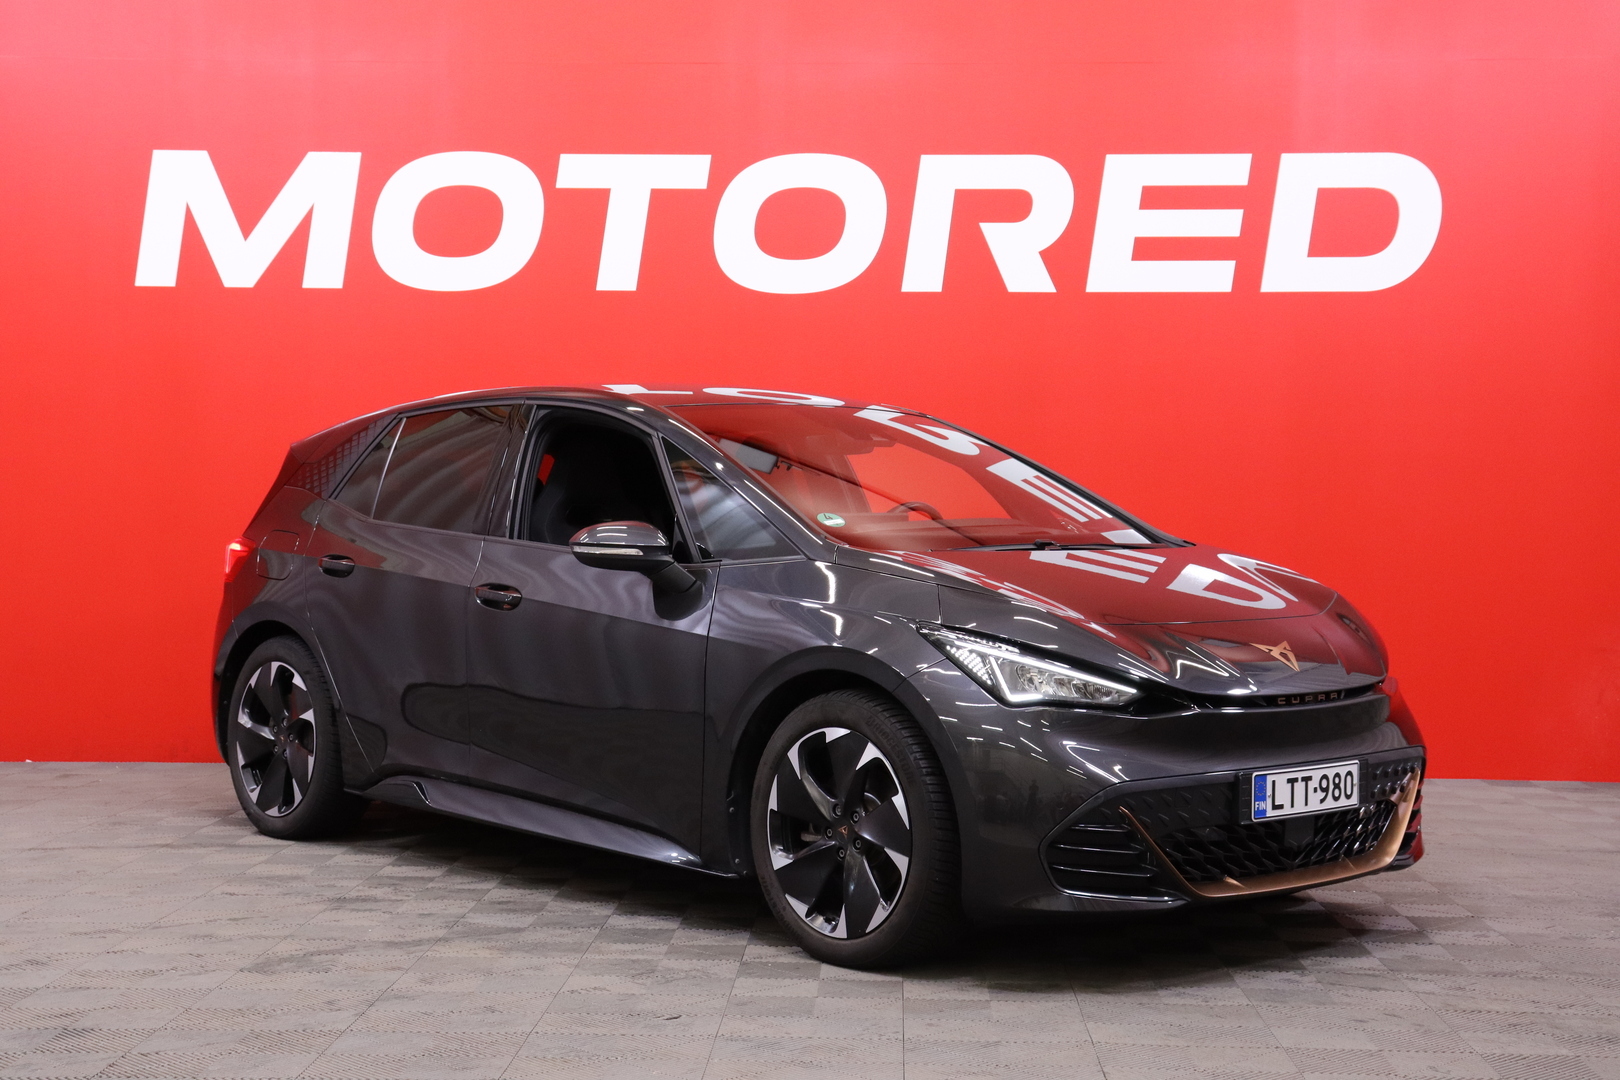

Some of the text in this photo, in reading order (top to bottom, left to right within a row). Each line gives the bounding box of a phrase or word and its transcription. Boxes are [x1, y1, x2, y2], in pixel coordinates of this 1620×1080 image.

[134, 149, 1442, 294] MOTORED
[1277, 691, 1338, 705] CUPRA
[1271, 769, 1354, 811] LTT-980
[1254, 800, 1267, 812] FIN
